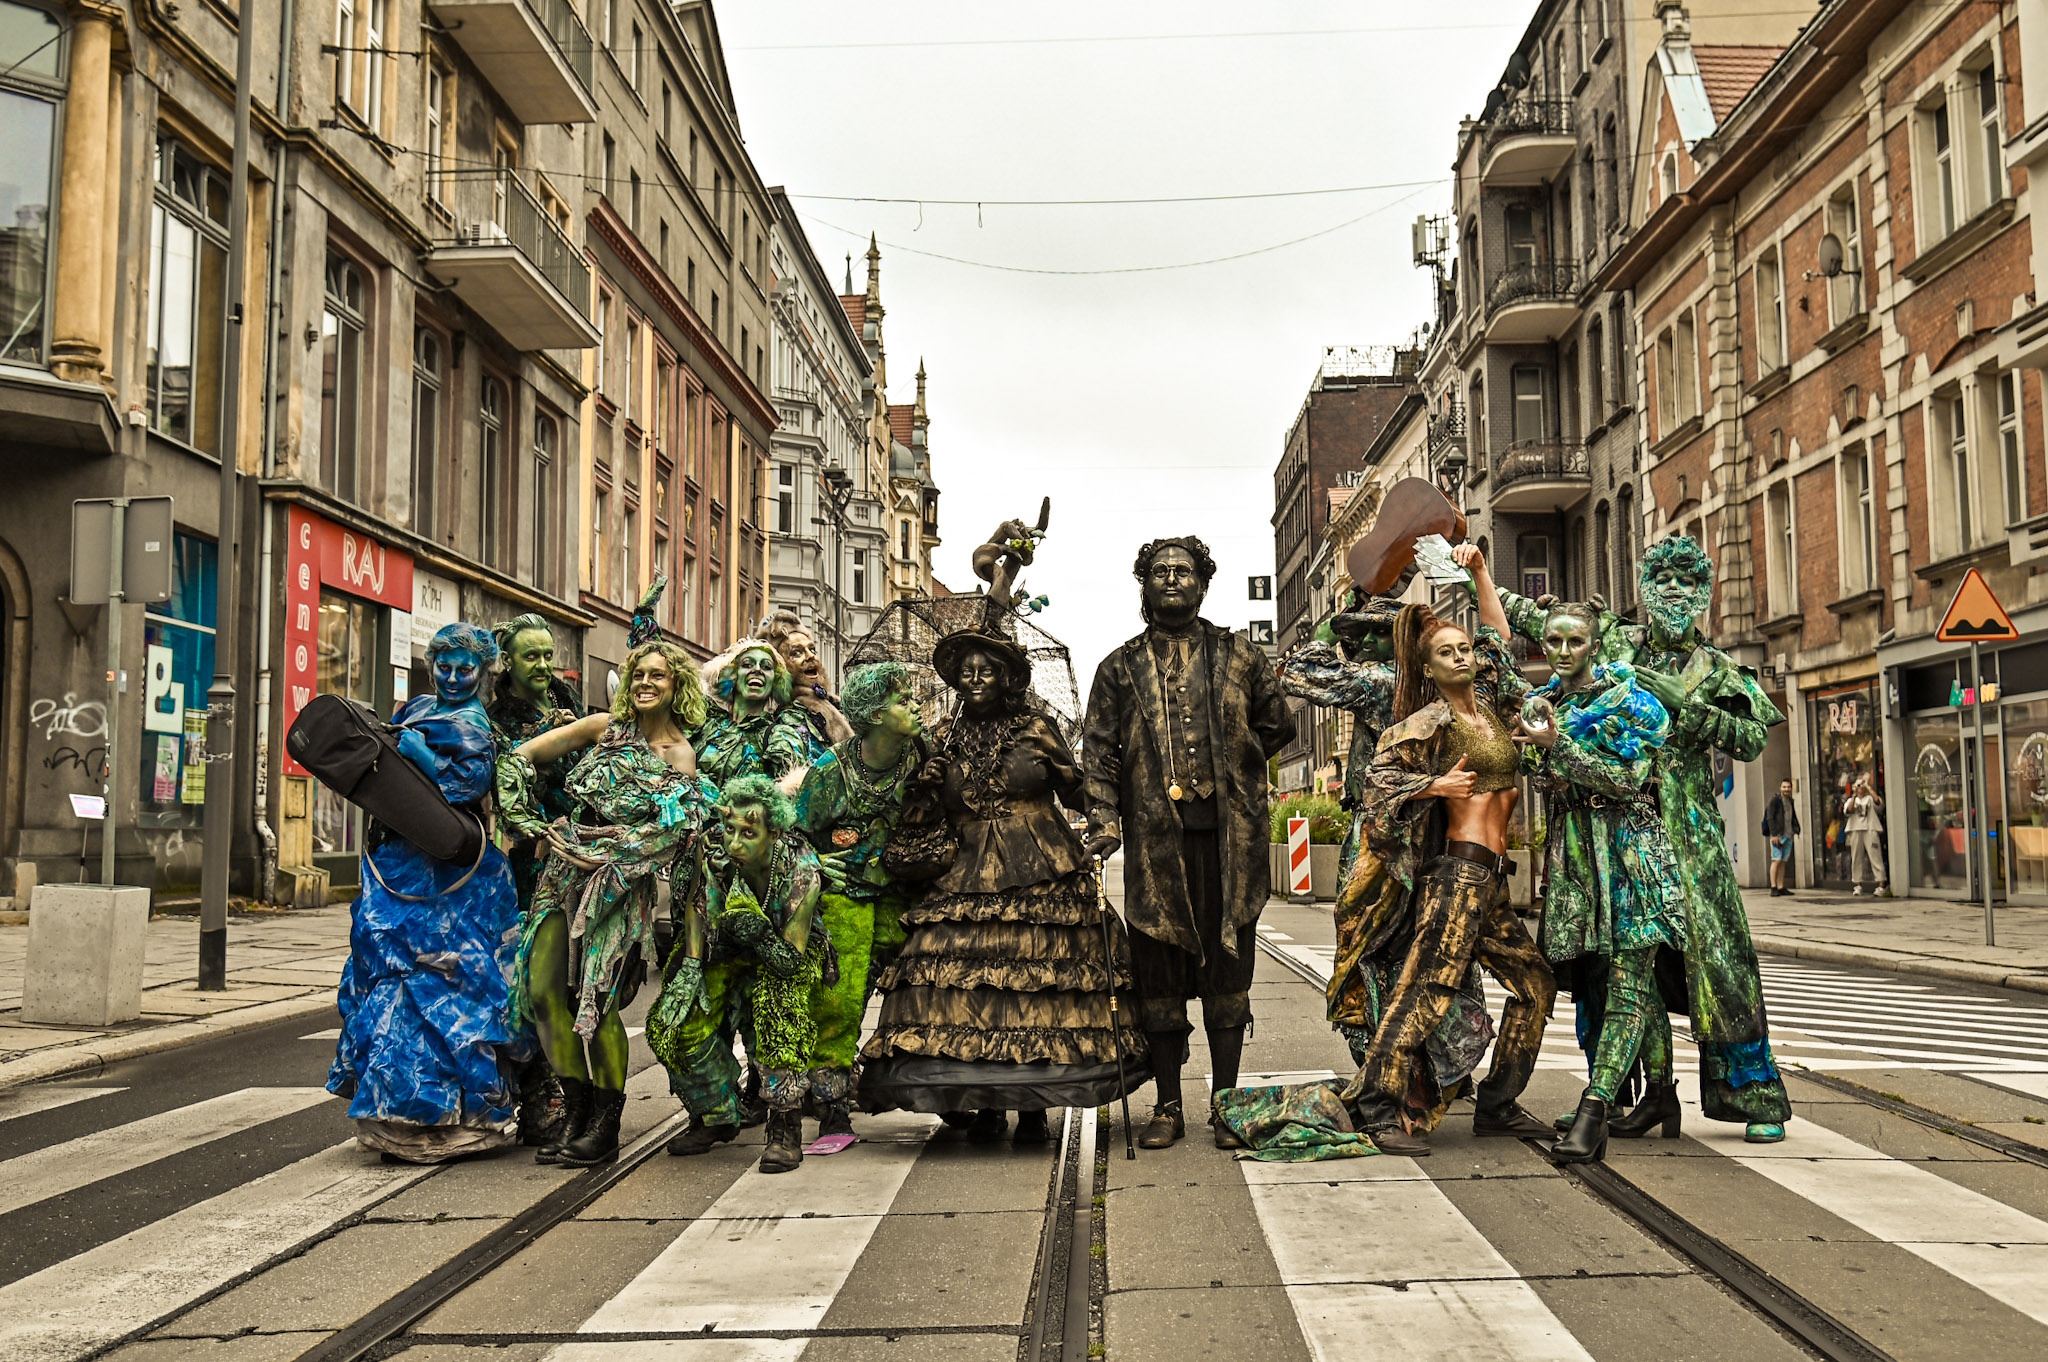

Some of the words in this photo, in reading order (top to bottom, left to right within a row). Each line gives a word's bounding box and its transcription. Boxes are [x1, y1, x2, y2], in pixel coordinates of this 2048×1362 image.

[343, 532, 385, 595] RAJ
[292, 522, 311, 764] cenow
[1828, 700, 1858, 735] RAJ
